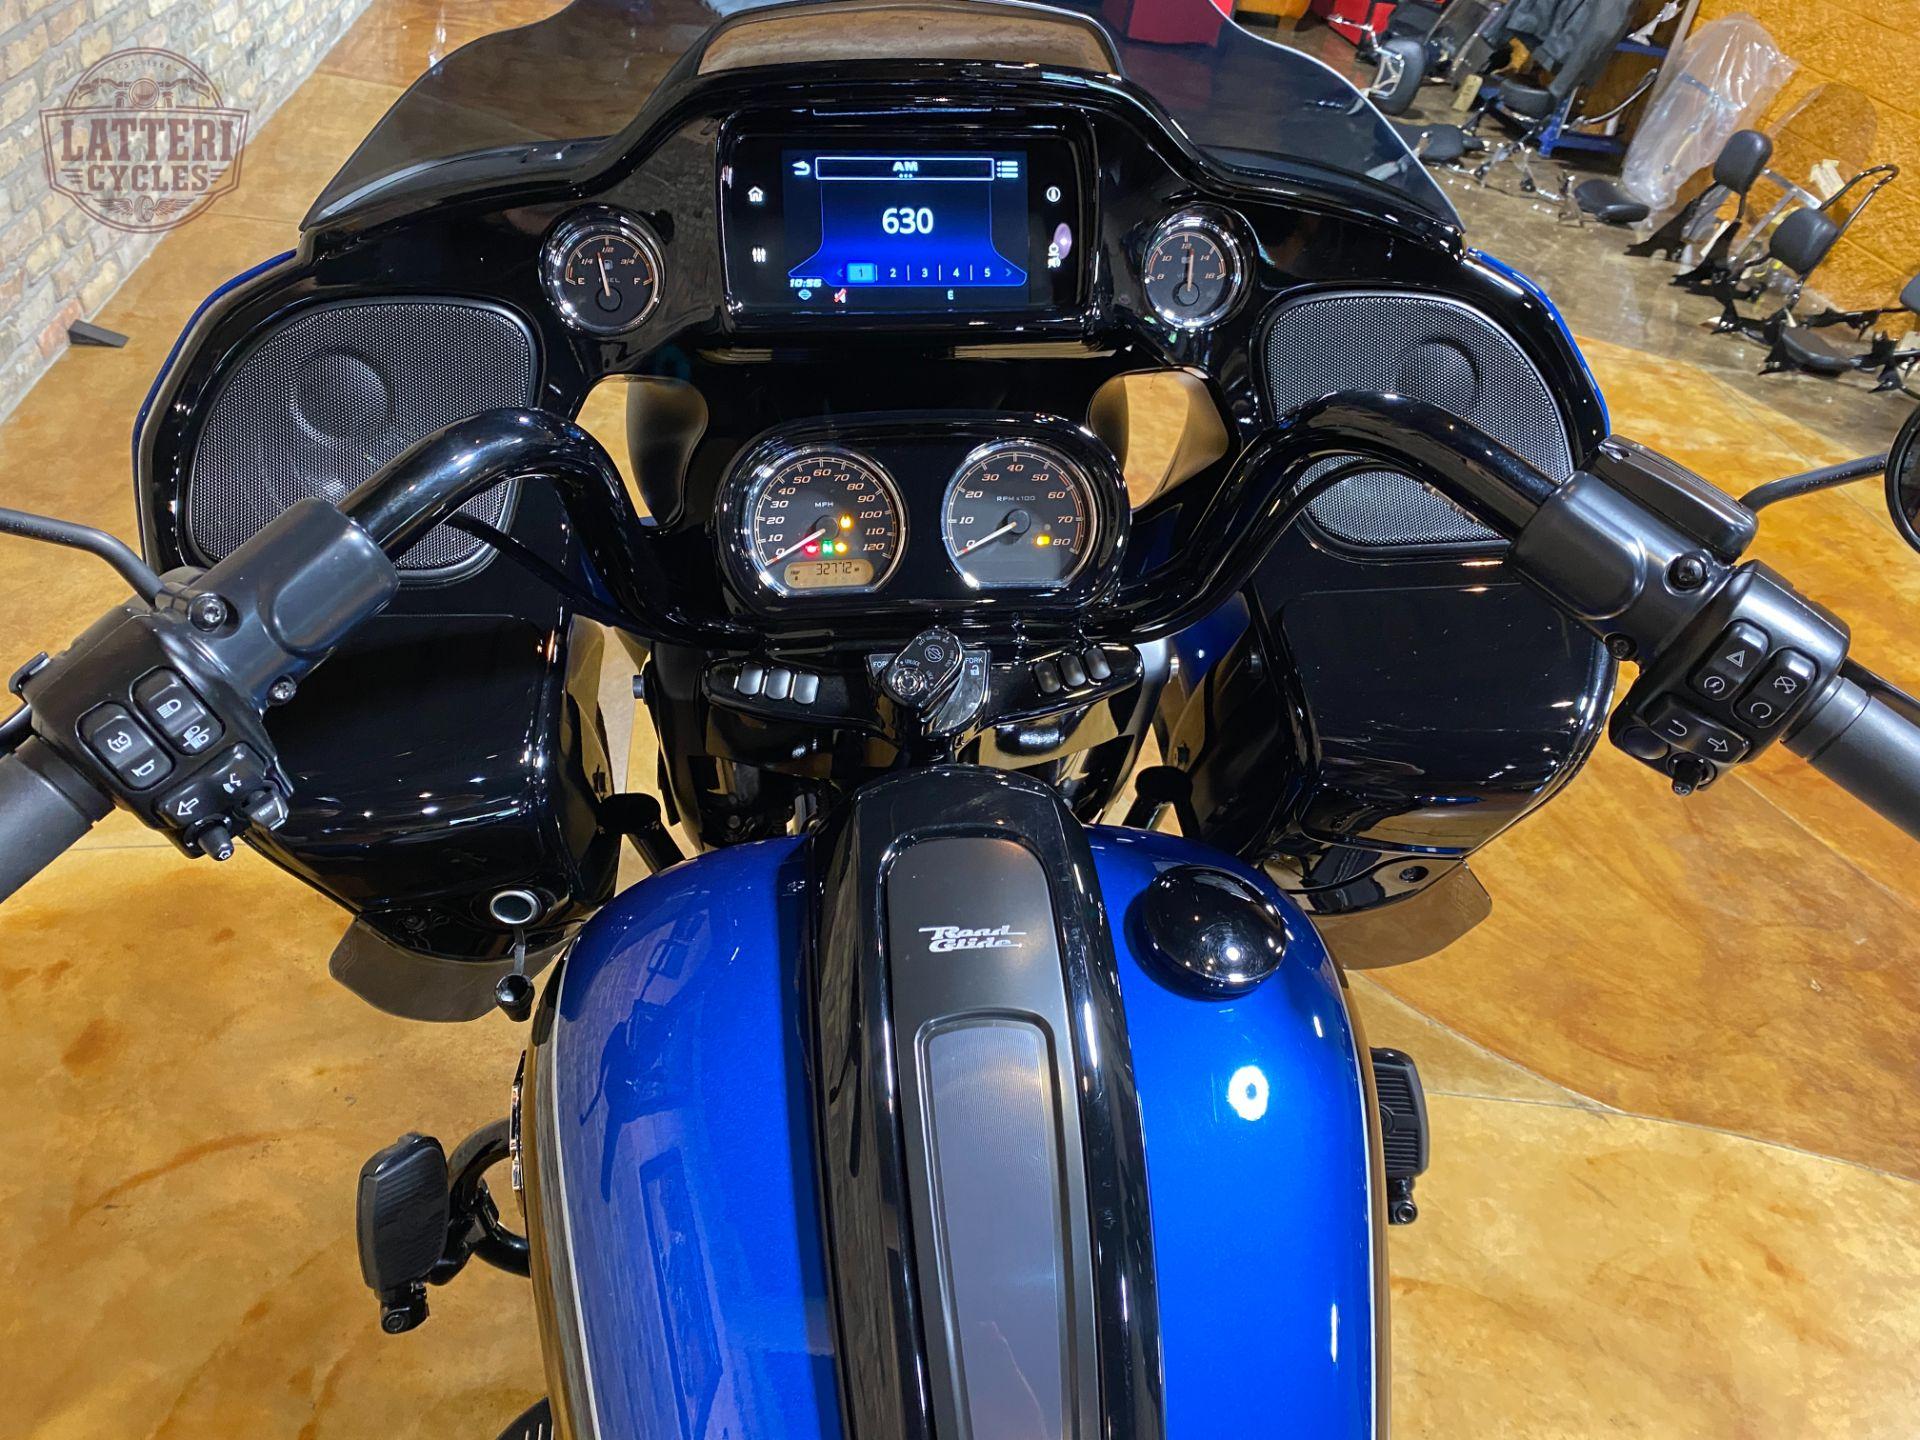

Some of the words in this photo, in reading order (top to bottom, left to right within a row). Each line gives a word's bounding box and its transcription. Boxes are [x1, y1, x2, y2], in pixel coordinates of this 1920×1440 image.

[892, 161, 918, 172] AM
[881, 207, 934, 234] 630
[889, 268, 897, 278] 2
[921, 268, 928, 278] 3
[952, 268, 960, 278] 4
[984, 268, 991, 278] 5
[577, 277, 585, 285] E
[633, 277, 641, 285] F
[813, 468, 832, 477] 60
[1006, 464, 1024, 472] 40
[792, 475, 811, 484] 50
[834, 474, 850, 482] 70
[981, 473, 1000, 482] 30
[1031, 473, 1049, 482] 50
[778, 487, 796, 495] 40
[846, 483, 865, 491] 80
[857, 494, 875, 503] 90
[964, 490, 983, 498] 20
[1047, 491, 1066, 499] 60
[770, 500, 789, 509] 30
[859, 510, 883, 519] 100
[766, 516, 785, 525] 20
[959, 516, 974, 525] 10
[1057, 516, 1073, 524] 70
[865, 527, 885, 536] 110
[768, 534, 783, 542] 10
[1052, 538, 1071, 546] 80
[862, 542, 885, 551] 120
[966, 539, 975, 547] 0
[775, 547, 785, 556] 0
[816, 561, 852, 576] 32772
[873, 660, 889, 669] FOR
[919, 924, 1027, 941] Road
[929, 937, 1023, 953] Glide
